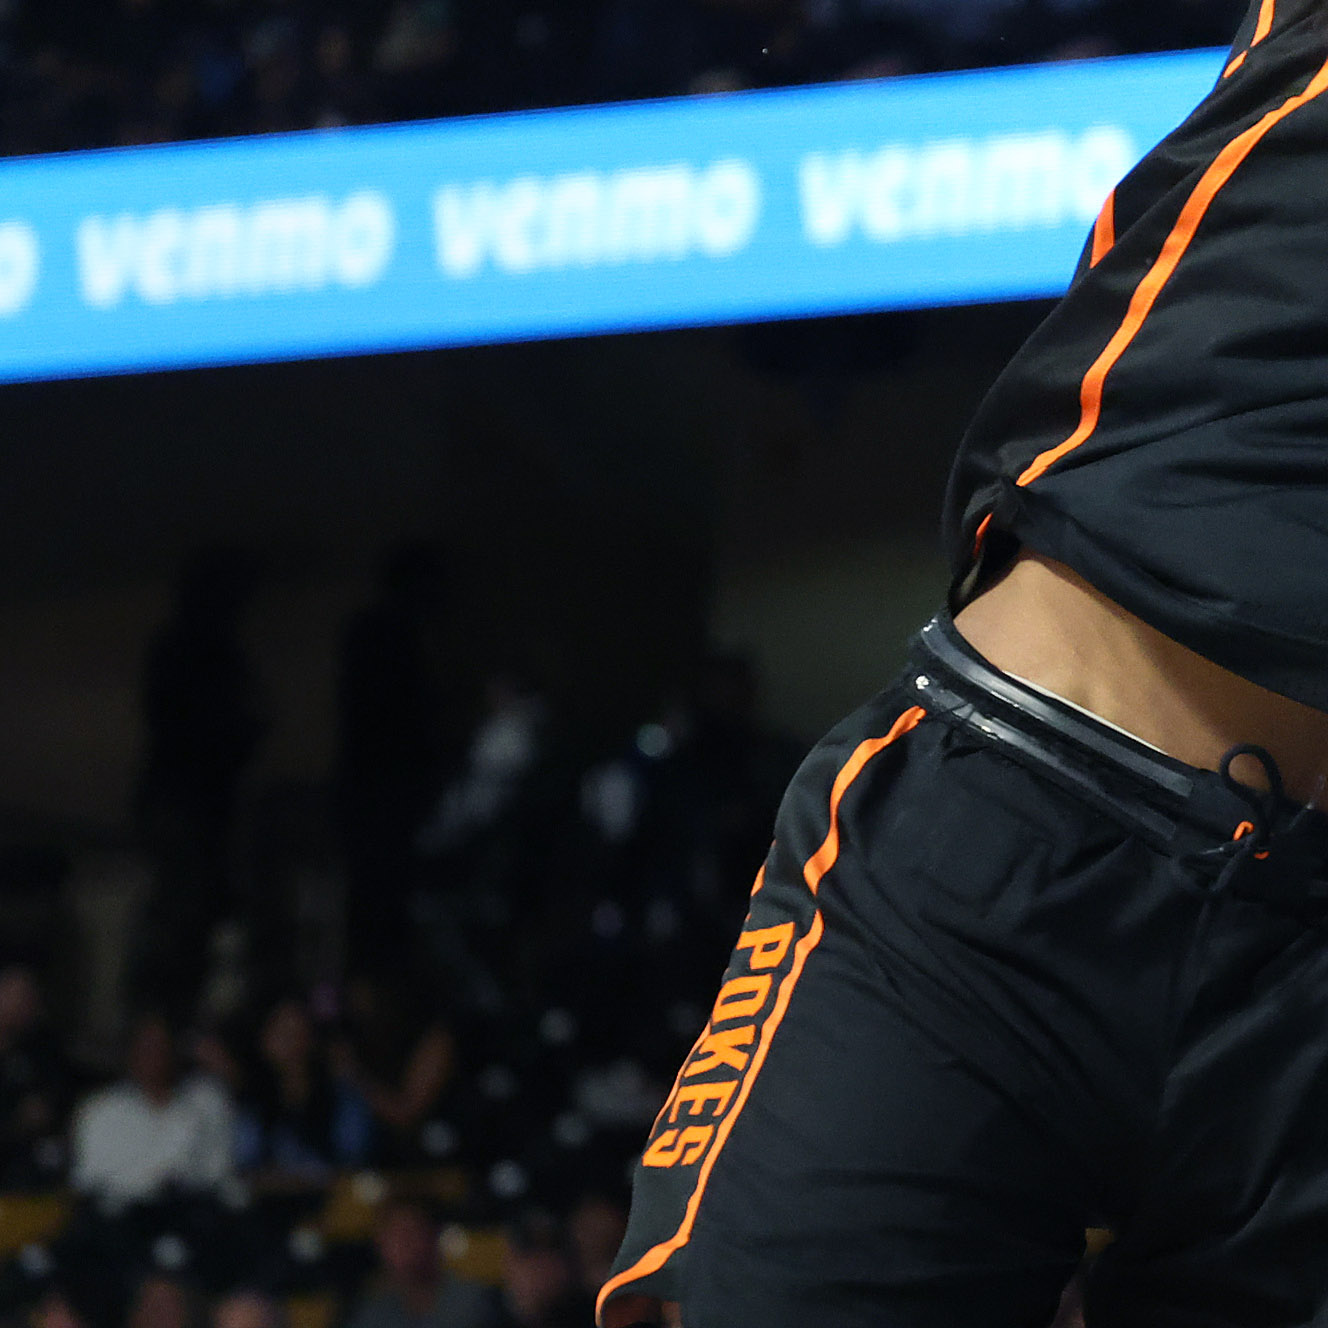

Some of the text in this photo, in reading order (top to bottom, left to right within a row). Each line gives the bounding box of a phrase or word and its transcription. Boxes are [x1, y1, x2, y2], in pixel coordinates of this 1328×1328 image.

[77, 190, 393, 310] venmo
[434, 159, 760, 276] venmo
[799, 126, 1136, 245] venmo
[641, 921, 796, 1168] POKES
